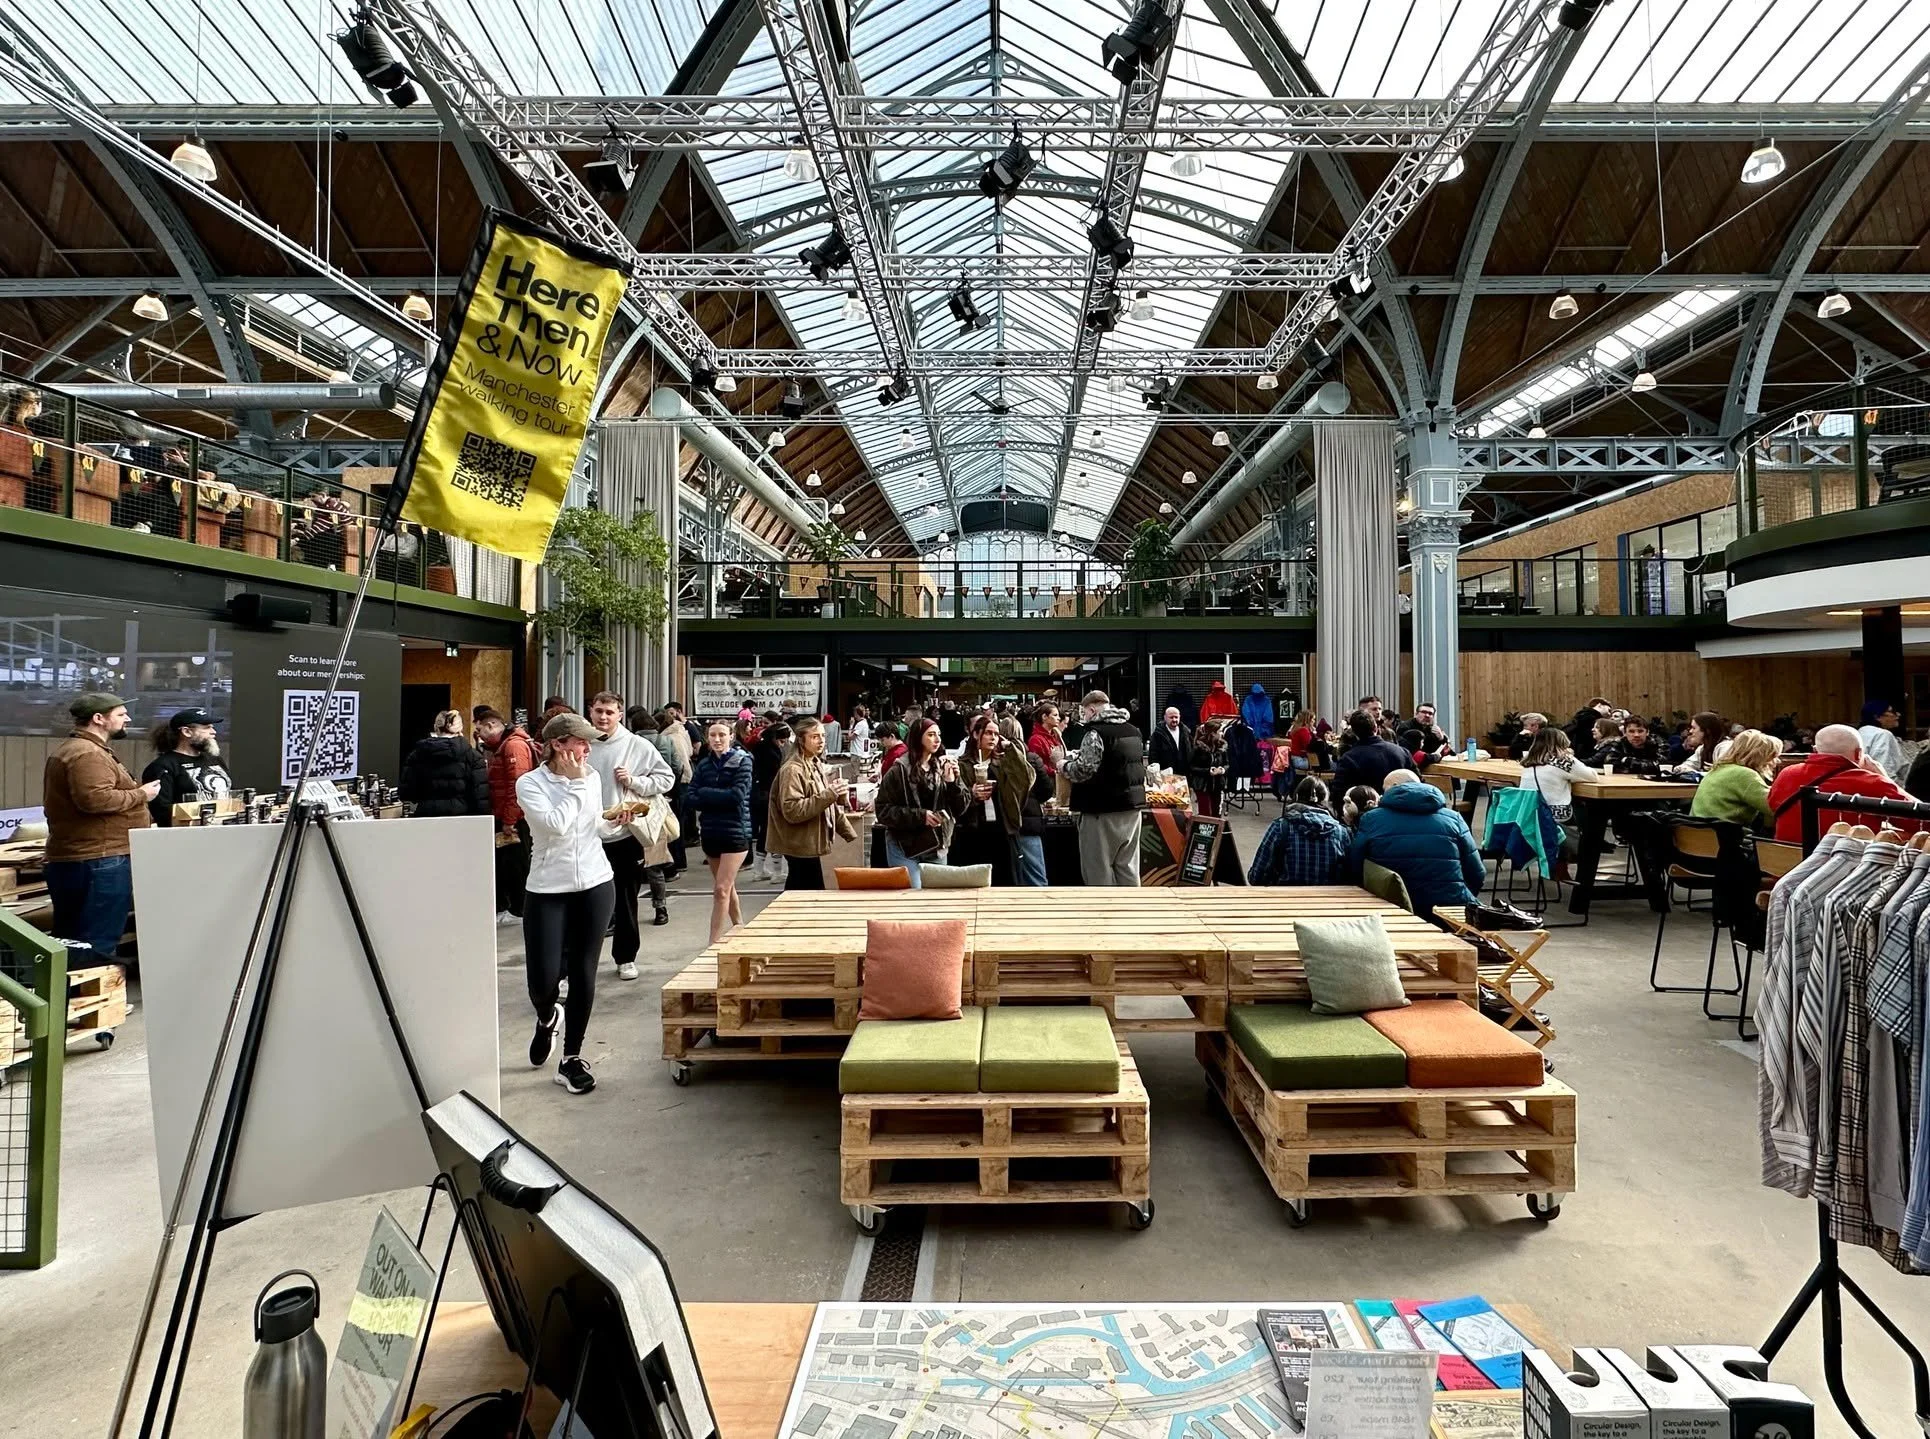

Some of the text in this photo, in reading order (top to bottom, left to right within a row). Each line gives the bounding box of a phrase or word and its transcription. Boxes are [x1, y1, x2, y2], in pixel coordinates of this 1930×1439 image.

[496, 255, 599, 320] Here
[477, 324, 501, 358] &
[494, 292, 589, 358] Then
[465, 362, 575, 416] Manchester
[459, 382, 571, 436] walking tour
[277, 668, 301, 677] about
[317, 671, 365, 681] meerships:
[289, 655, 308, 663] Scan
[376, 1243, 398, 1277] OUT
[394, 1269, 409, 1294] ON
[1583, 1422, 1613, 1430] Circular
[1598, 1431, 1611, 1439] key
[1677, 1428, 1690, 1436] key
